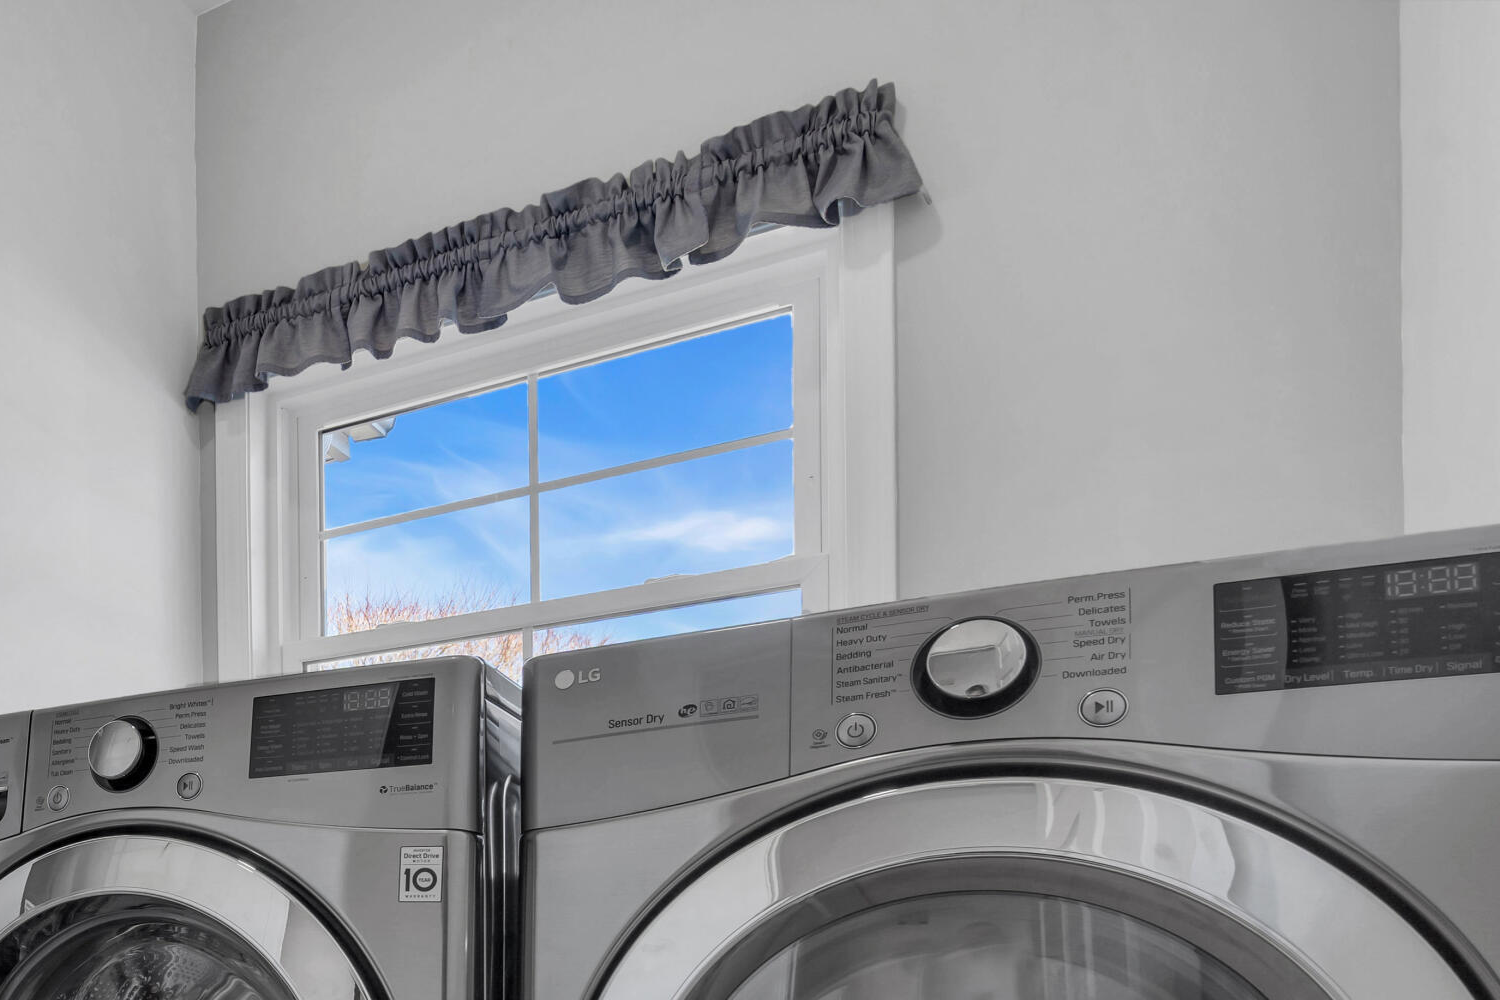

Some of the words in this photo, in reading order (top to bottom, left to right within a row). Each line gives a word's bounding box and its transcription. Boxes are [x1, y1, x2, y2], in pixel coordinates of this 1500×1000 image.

[1097, 590, 1126, 600] Press
[1078, 604, 1126, 616] Delicates
[1089, 617, 1126, 627] Towels
[1220, 619, 1251, 629] Reduce
[836, 624, 868, 634] Normal
[836, 638, 864, 647] Heavy
[866, 634, 888, 644] Duty
[1072, 636, 1105, 648] Speed
[1107, 635, 1126, 646] Dry
[835, 650, 872, 661] Bedding
[1090, 652, 1106, 661] Air
[1108, 651, 1126, 662] Dry
[836, 661, 894, 674] Antibacterial
[1388, 665, 1413, 675] Time
[1414, 663, 1434, 674] Dry
[1446, 659, 1483, 672] Signal
[577, 668, 602, 684] LG
[1062, 666, 1127, 679] Downloaded
[1284, 674, 1303, 685] Dry
[1303, 671, 1331, 682] Level
[835, 679, 862, 689] Steam
[1224, 676, 1254, 685] Custom
[835, 694, 864, 703] Steam
[169, 702, 186, 711] Bright
[179, 721, 206, 730] Delicates
[608, 714, 643, 729] Sensor
[645, 713, 665, 724] Dry
[184, 732, 205, 740] Towels
[169, 745, 189, 754] Speed
[189, 743, 205, 751] Wash
[168, 756, 204, 765] Downloaded
[404, 867, 438, 892] 10
